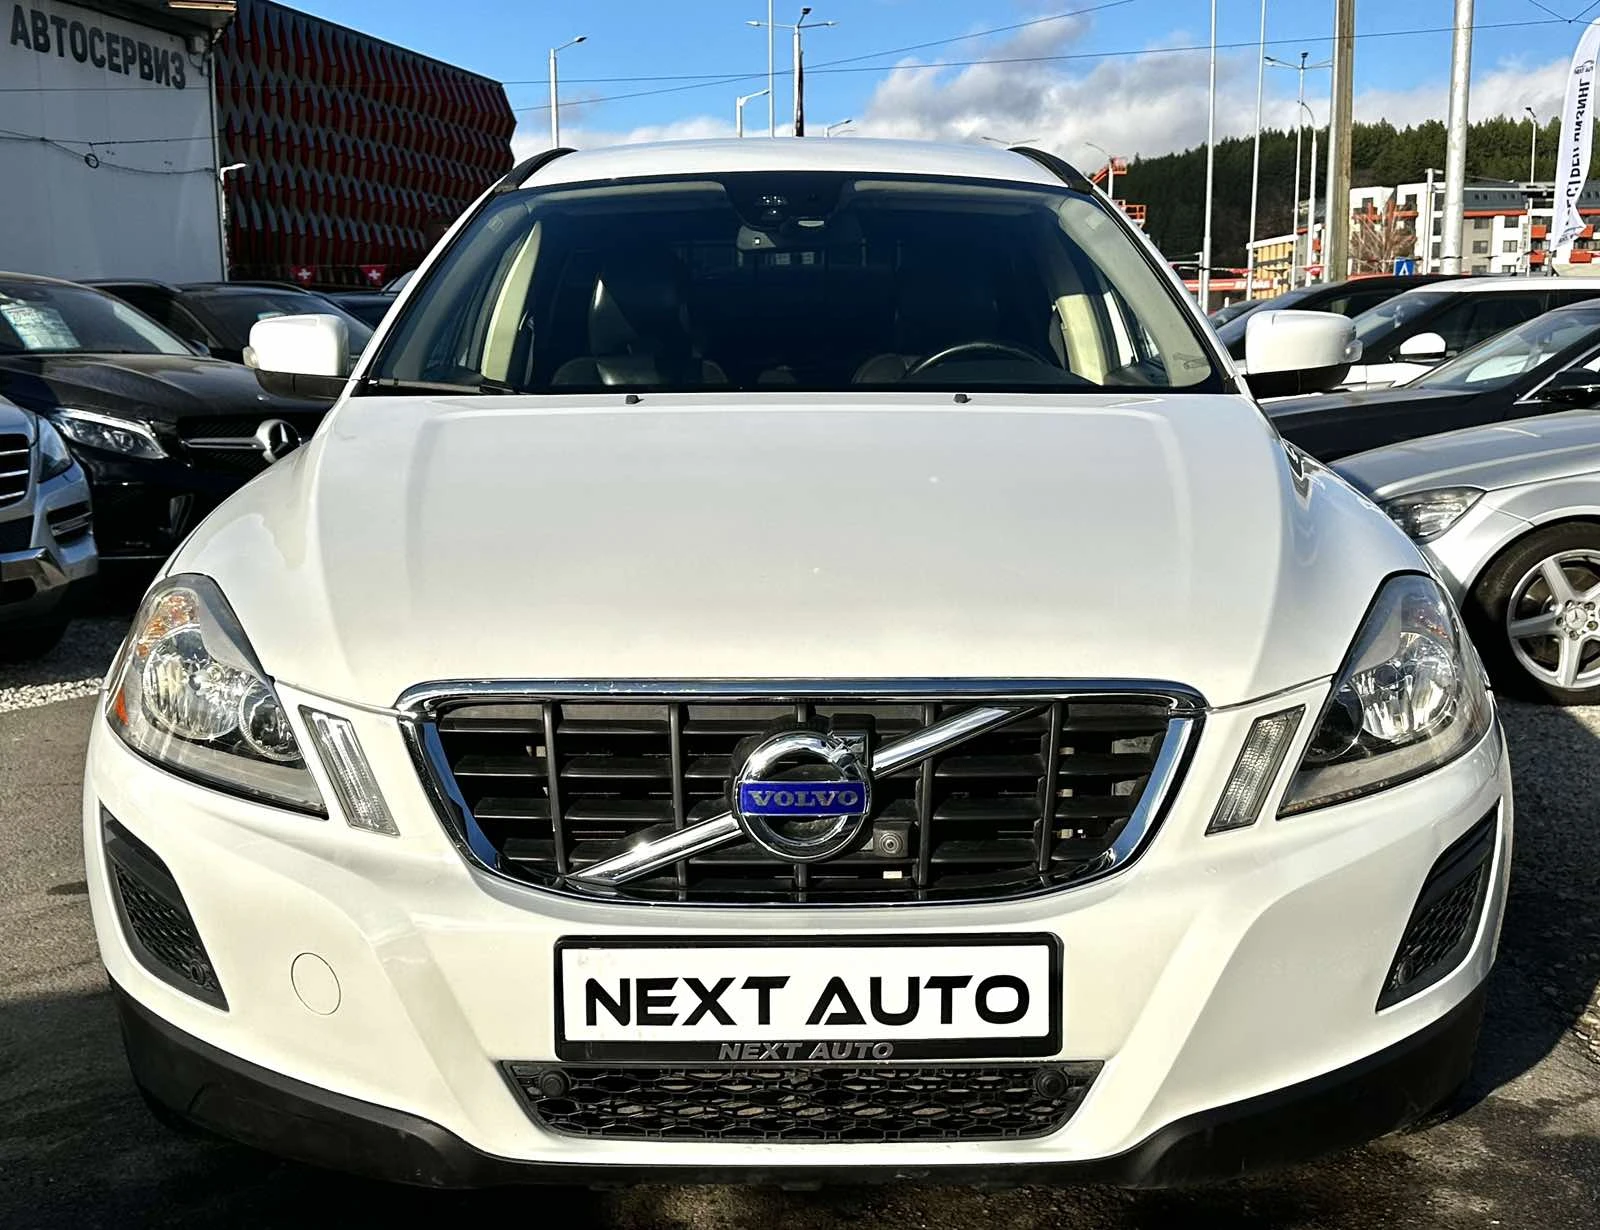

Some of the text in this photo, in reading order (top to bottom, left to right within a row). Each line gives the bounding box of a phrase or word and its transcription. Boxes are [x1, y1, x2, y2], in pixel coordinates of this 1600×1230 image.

[10, 4, 186, 90] АВТОСЕРВИЗ
[748, 790, 858, 807] VOLVO
[585, 974, 1030, 1026] NEXT AUTO
[718, 1042, 895, 1061] NEXT AUTO
